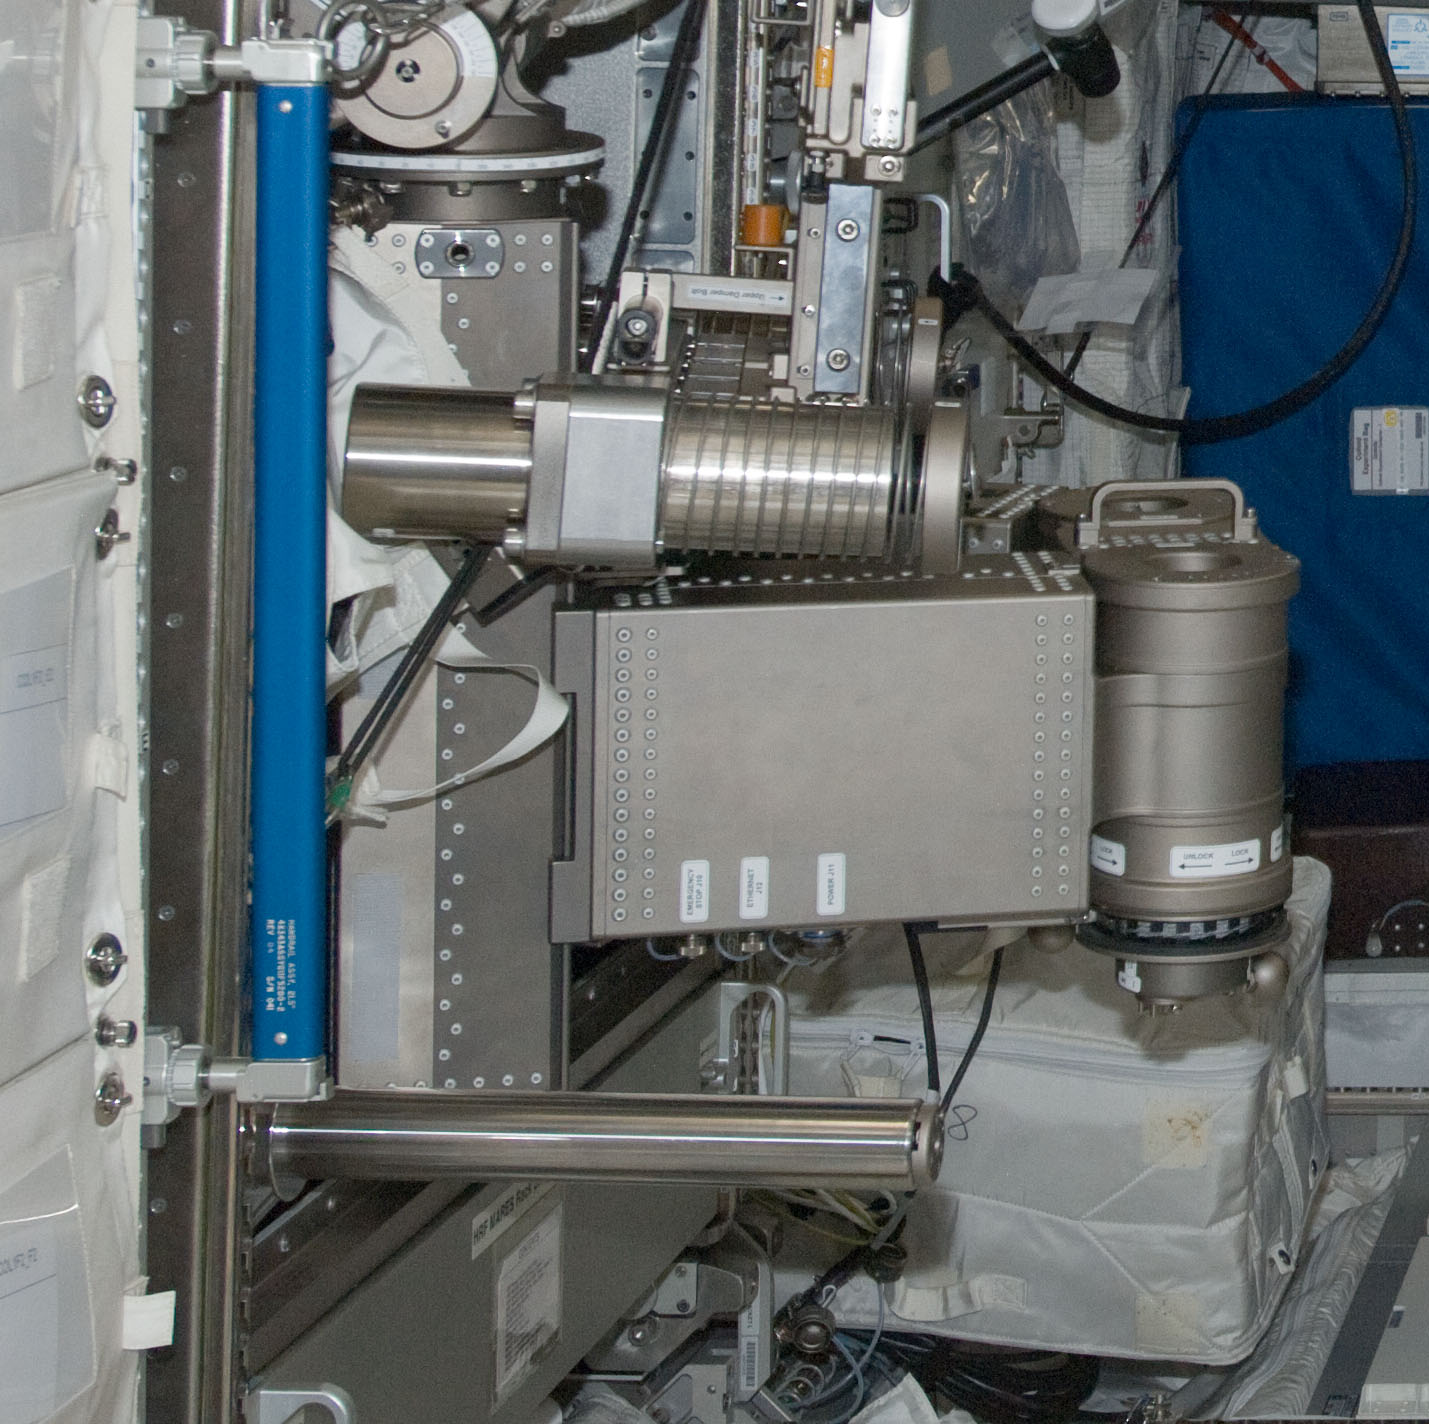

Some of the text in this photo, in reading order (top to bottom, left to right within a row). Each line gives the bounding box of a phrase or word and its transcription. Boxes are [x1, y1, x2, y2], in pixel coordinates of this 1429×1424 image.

[1361, 437, 1370, 476] Experiment
[1183, 848, 1249, 860] UNLOCK LOCK
[686, 869, 694, 916] EMERGENCY
[695, 888, 703, 909] STOP
[746, 868, 755, 908] ETHERNET
[827, 878, 835, 906] POWER
[265, 919, 275, 936] REV
[287, 919, 297, 957] HANDRAIL
[473, 1183, 531, 1246] HRF MARES Rack
